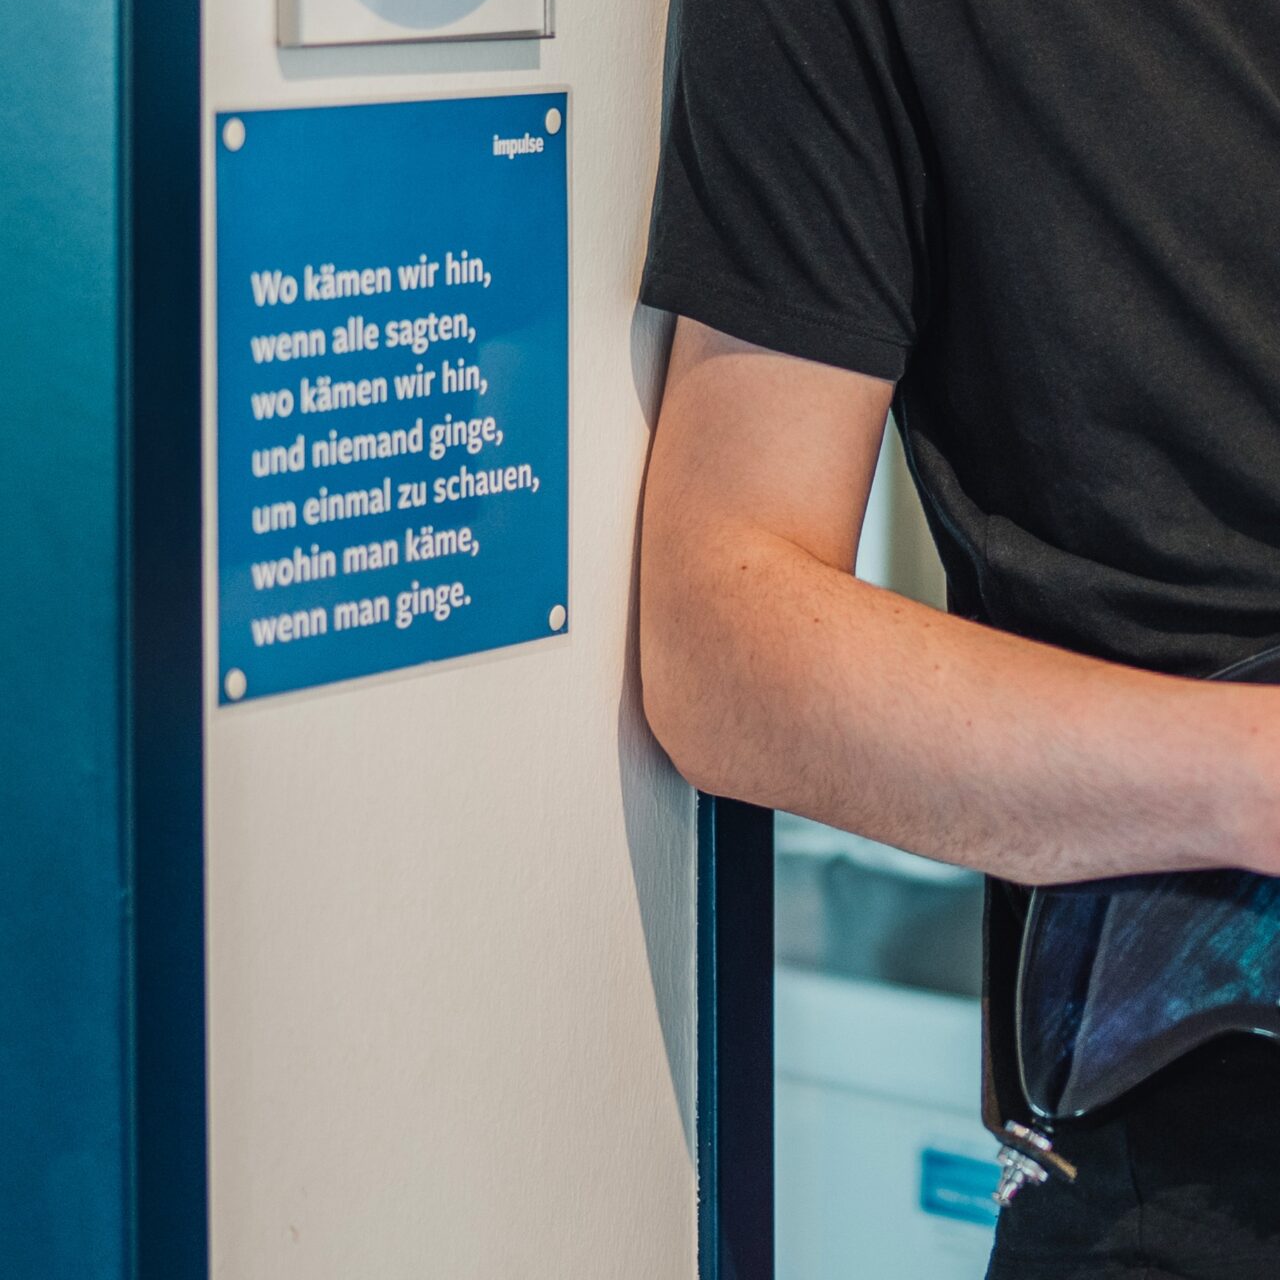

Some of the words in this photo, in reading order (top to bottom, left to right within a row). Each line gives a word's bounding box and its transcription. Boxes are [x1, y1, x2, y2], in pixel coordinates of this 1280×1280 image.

[493, 132, 544, 159] impulse
[251, 269, 298, 306] Wo
[304, 263, 391, 302] kämen
[397, 254, 439, 291] wir
[445, 250, 491, 288] hin,
[251, 328, 326, 364] wenn
[332, 316, 379, 354] alle
[385, 312, 476, 354] sagten,
[251, 389, 294, 420] wo
[301, 376, 387, 413] kämen
[394, 363, 436, 400] wir
[442, 359, 488, 395] hin,
[252, 434, 305, 477] und
[312, 418, 424, 468] niemand
[430, 413, 503, 460] ginge,
[252, 499, 297, 534] um
[303, 477, 391, 525] einmal
[397, 482, 426, 510] zu
[433, 463, 540, 504] schauen,
[251, 544, 336, 591] wohin
[343, 539, 398, 574] man
[405, 526, 479, 563] käme,
[251, 608, 327, 647] wenn
[334, 596, 389, 630] man
[396, 581, 471, 629] ginge.
